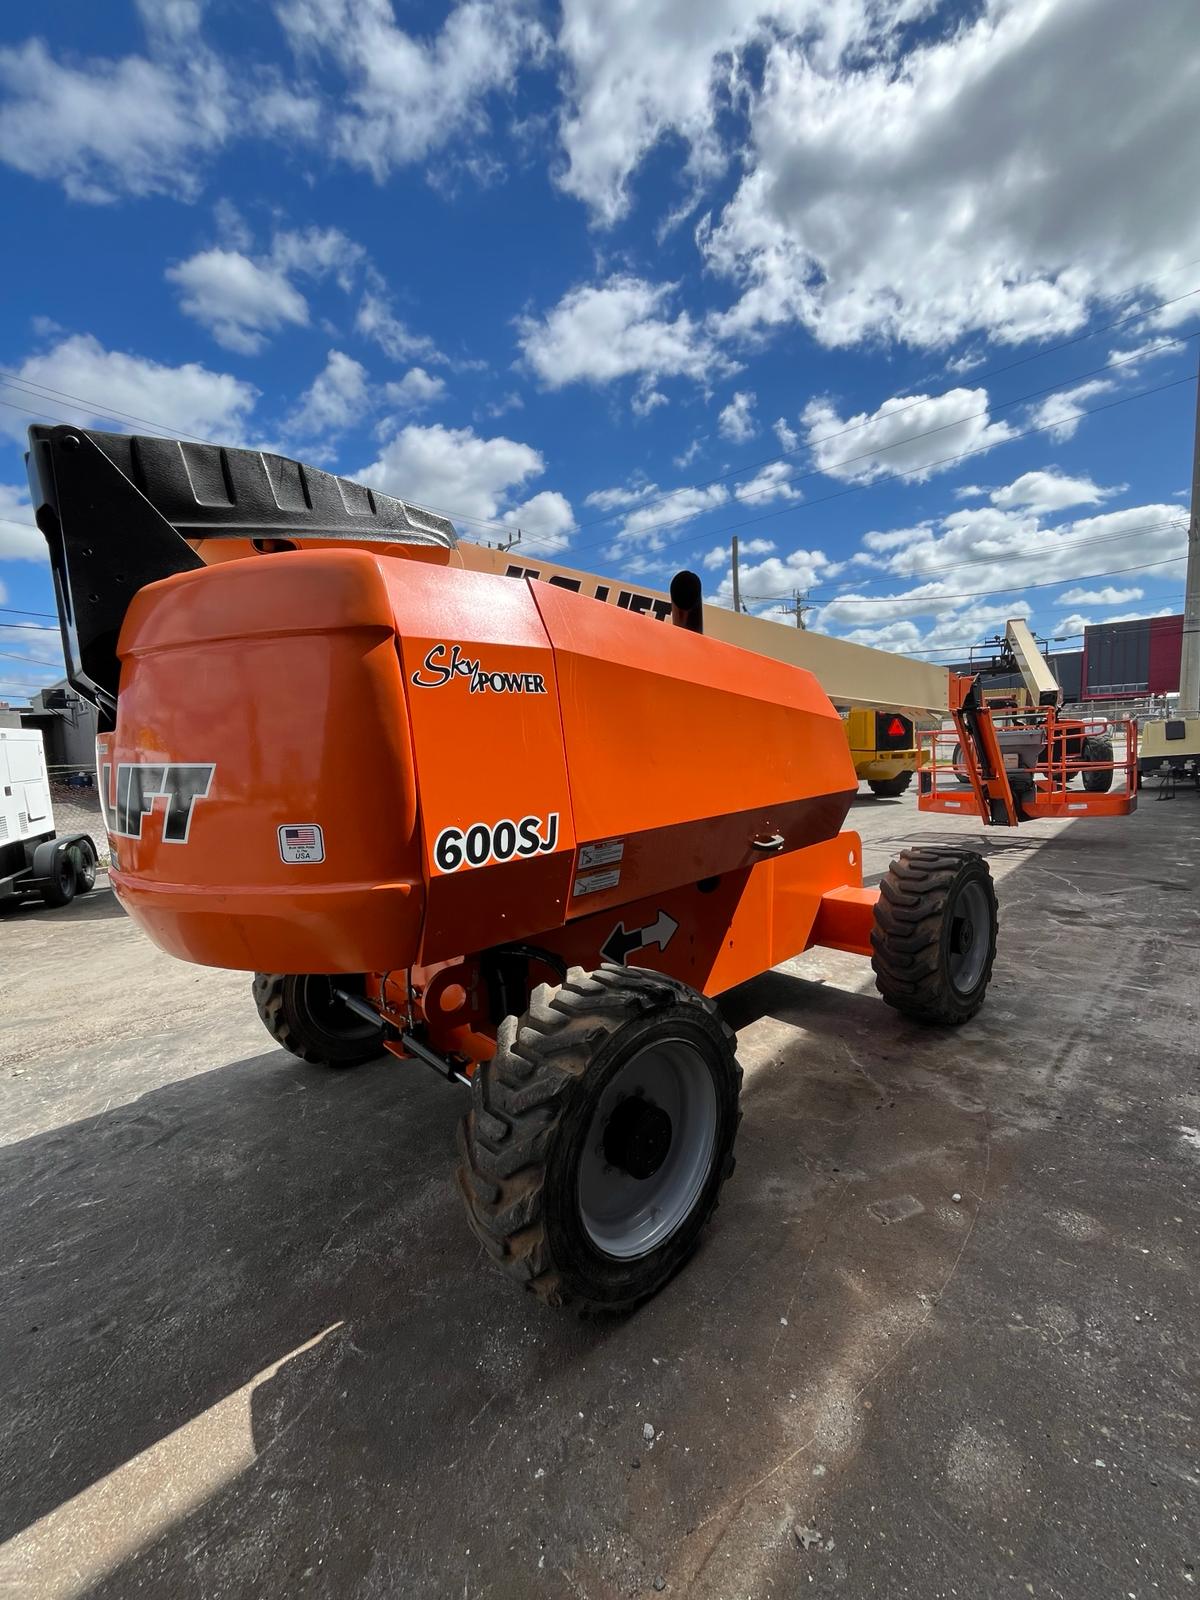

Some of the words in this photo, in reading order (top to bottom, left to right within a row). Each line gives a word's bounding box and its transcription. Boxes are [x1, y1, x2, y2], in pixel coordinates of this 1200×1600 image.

[411, 644, 480, 693] Sky
[477, 672, 547, 693] POWER
[435, 813, 559, 873] 600SJ
